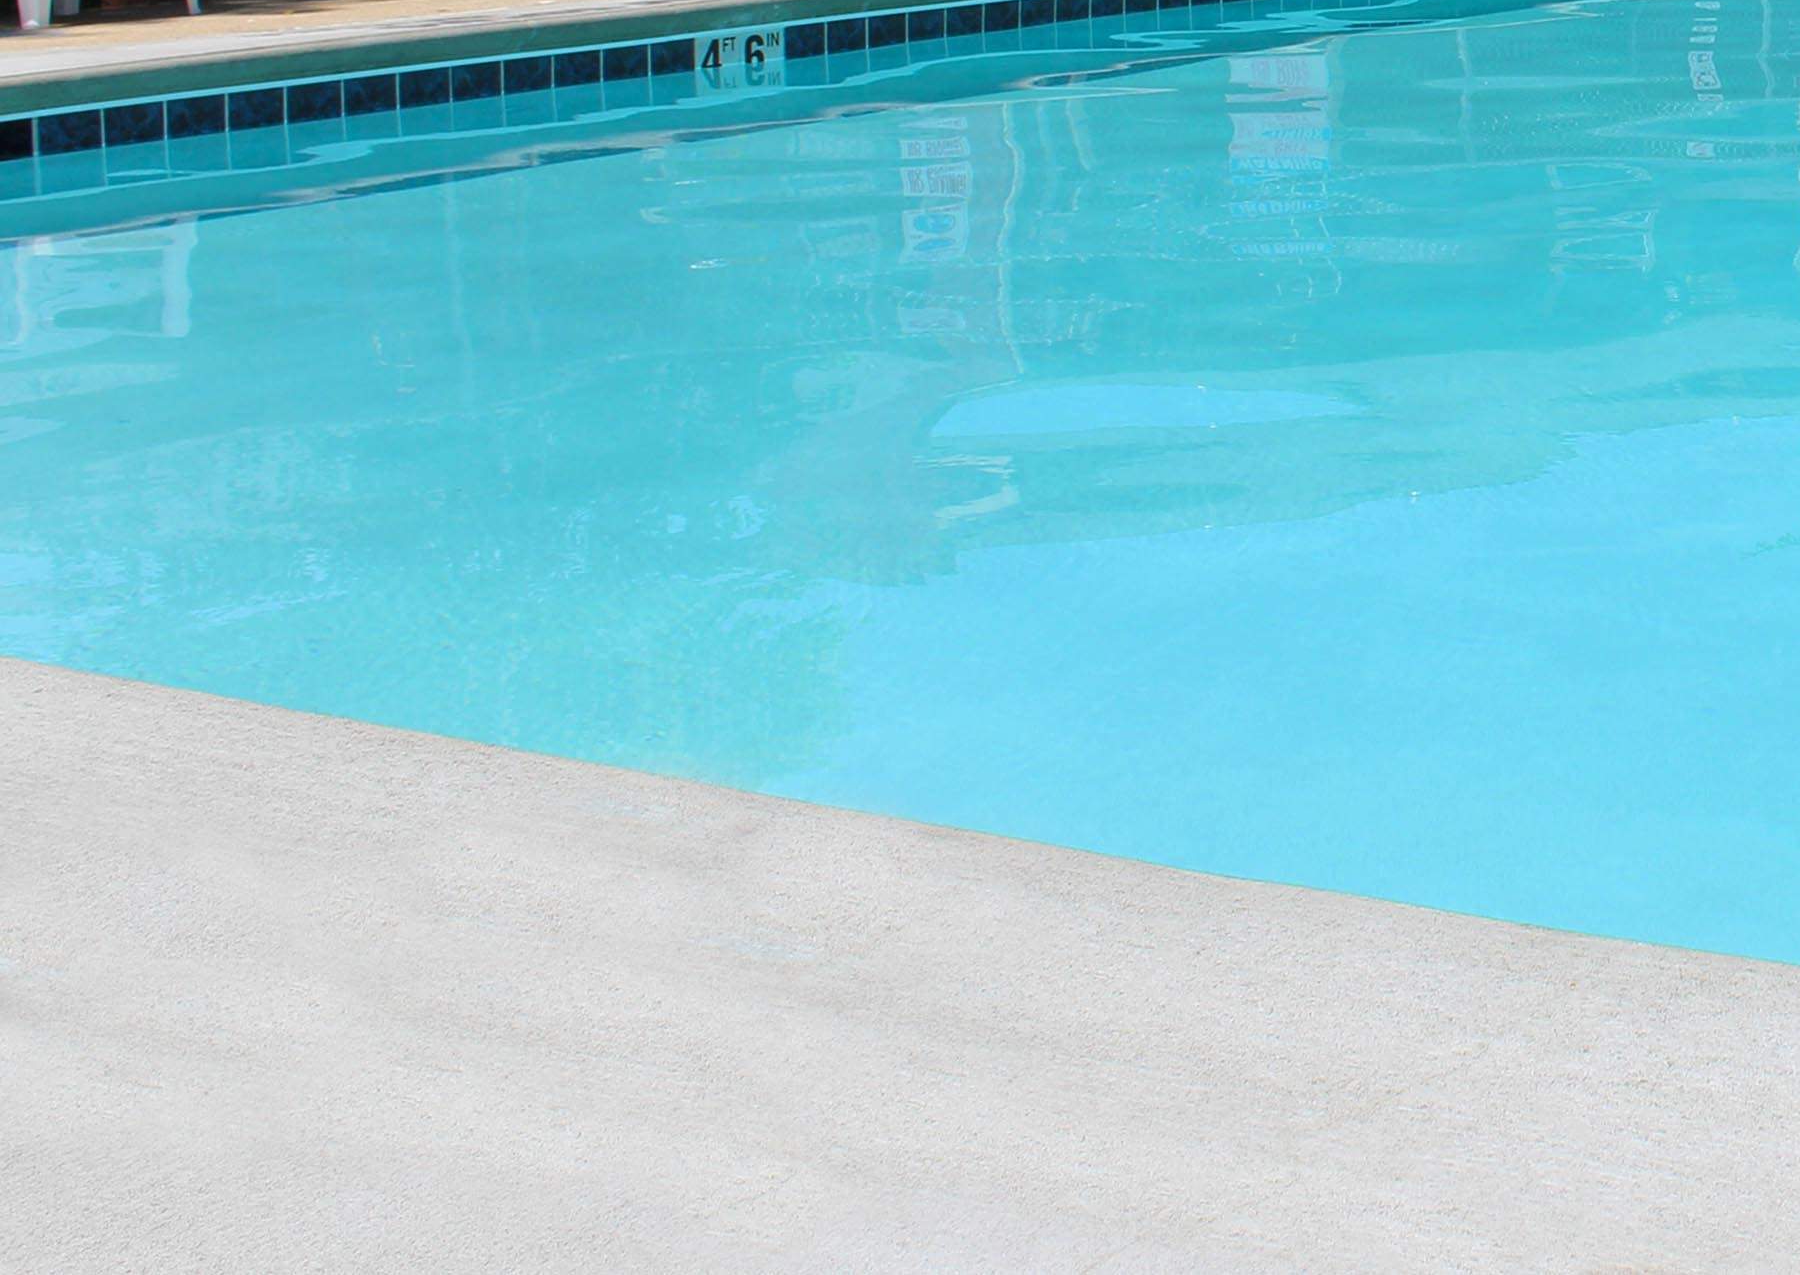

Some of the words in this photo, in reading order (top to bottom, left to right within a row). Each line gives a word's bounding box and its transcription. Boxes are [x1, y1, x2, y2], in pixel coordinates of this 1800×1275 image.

[701, 39, 722, 68] 4
[723, 37, 736, 52] FT
[745, 34, 764, 69] 6
[766, 32, 780, 47] IN
